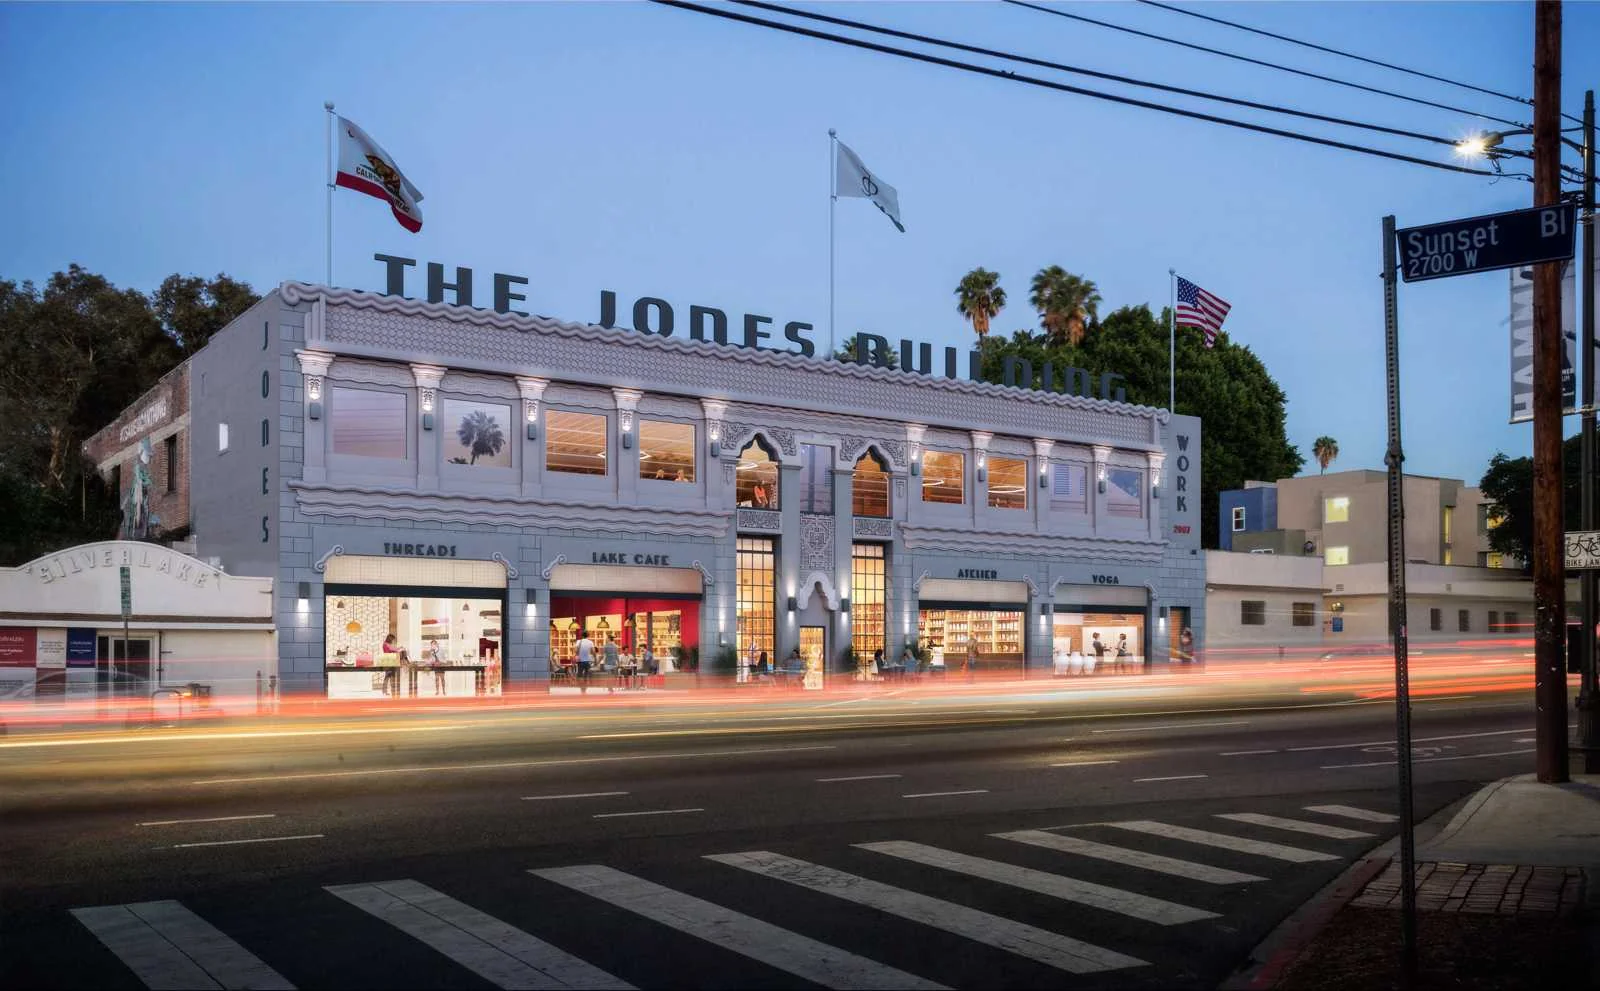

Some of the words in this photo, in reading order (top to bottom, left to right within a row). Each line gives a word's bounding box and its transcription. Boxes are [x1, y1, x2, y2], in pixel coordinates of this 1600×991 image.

[1408, 219, 1499, 258] Sunset
[1541, 208, 1567, 238] Bl
[1409, 252, 1455, 277] 2700
[1464, 250, 1479, 268] W
[374, 253, 529, 316] THE
[589, 290, 815, 357] JONES
[856, 331, 1127, 403] BUILDING
[261, 321, 270, 543] JONES
[1176, 435, 1190, 512] WORK
[383, 542, 457, 557] THREADS
[592, 552, 627, 564] LAKE
[634, 553, 670, 566] CAFE
[1566, 559, 1582, 567] BIKE
[1585, 558, 1600, 567] LAN
[957, 568, 997, 579] ATELIER
[1092, 574, 1119, 584] YOGA
